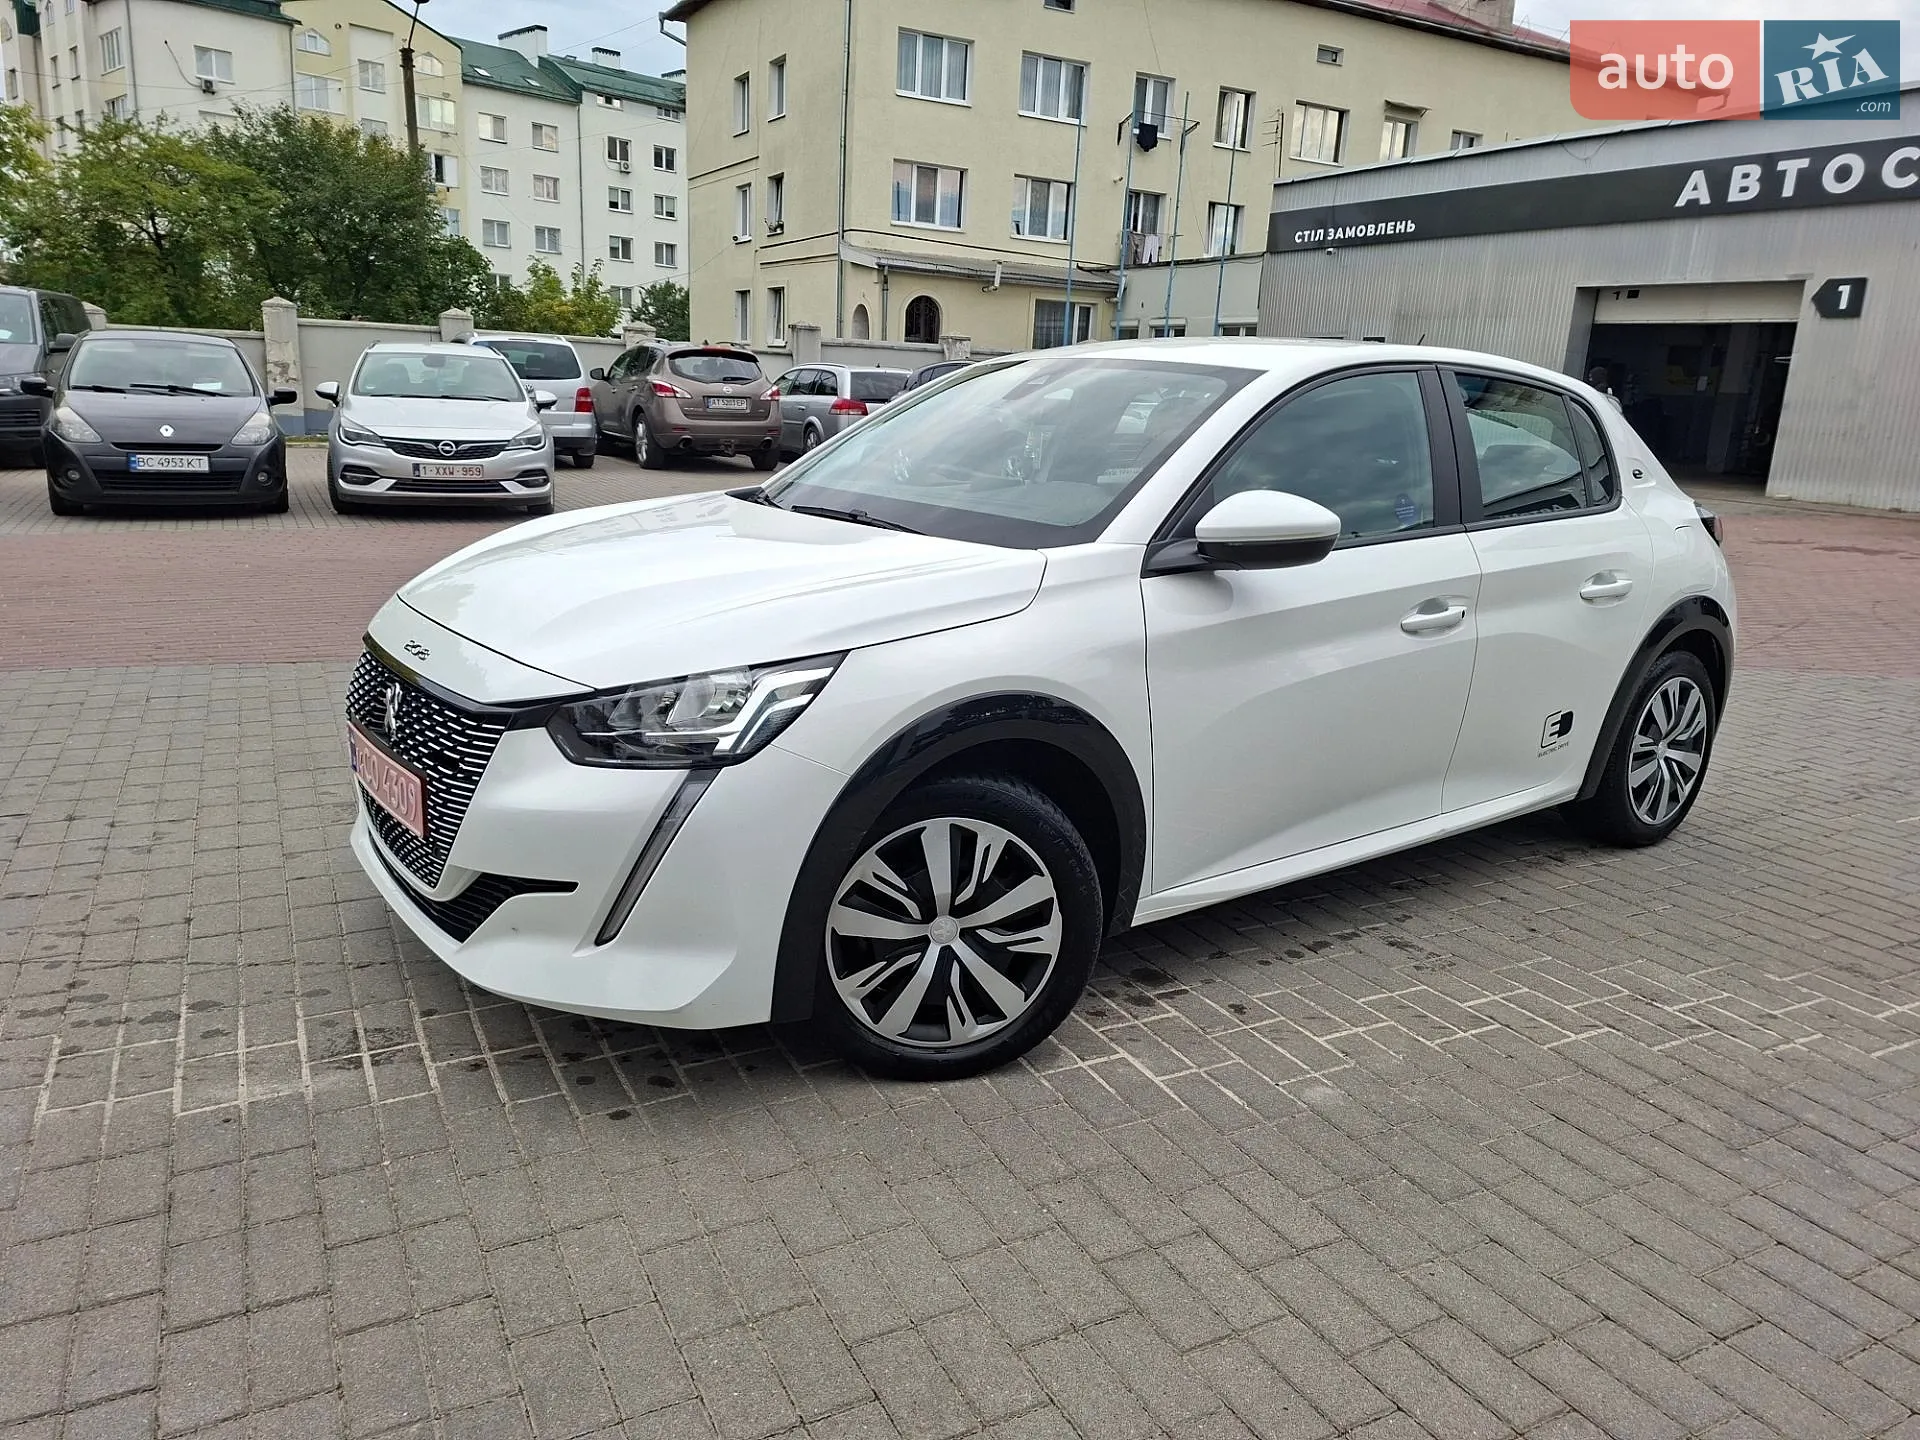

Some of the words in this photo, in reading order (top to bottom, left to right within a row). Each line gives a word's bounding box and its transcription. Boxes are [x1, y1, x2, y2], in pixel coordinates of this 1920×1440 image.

[1294, 228, 1325, 243] СТІЛ
[1327, 220, 1416, 240] ЗАМОВЛЕНЬ
[1612, 291, 1620, 300] 1
[1837, 285, 1851, 310] 1
[137, 457, 154, 467] BC
[157, 457, 184, 468] 4953
[186, 458, 204, 468] KT
[383, 765, 416, 821] 4309
